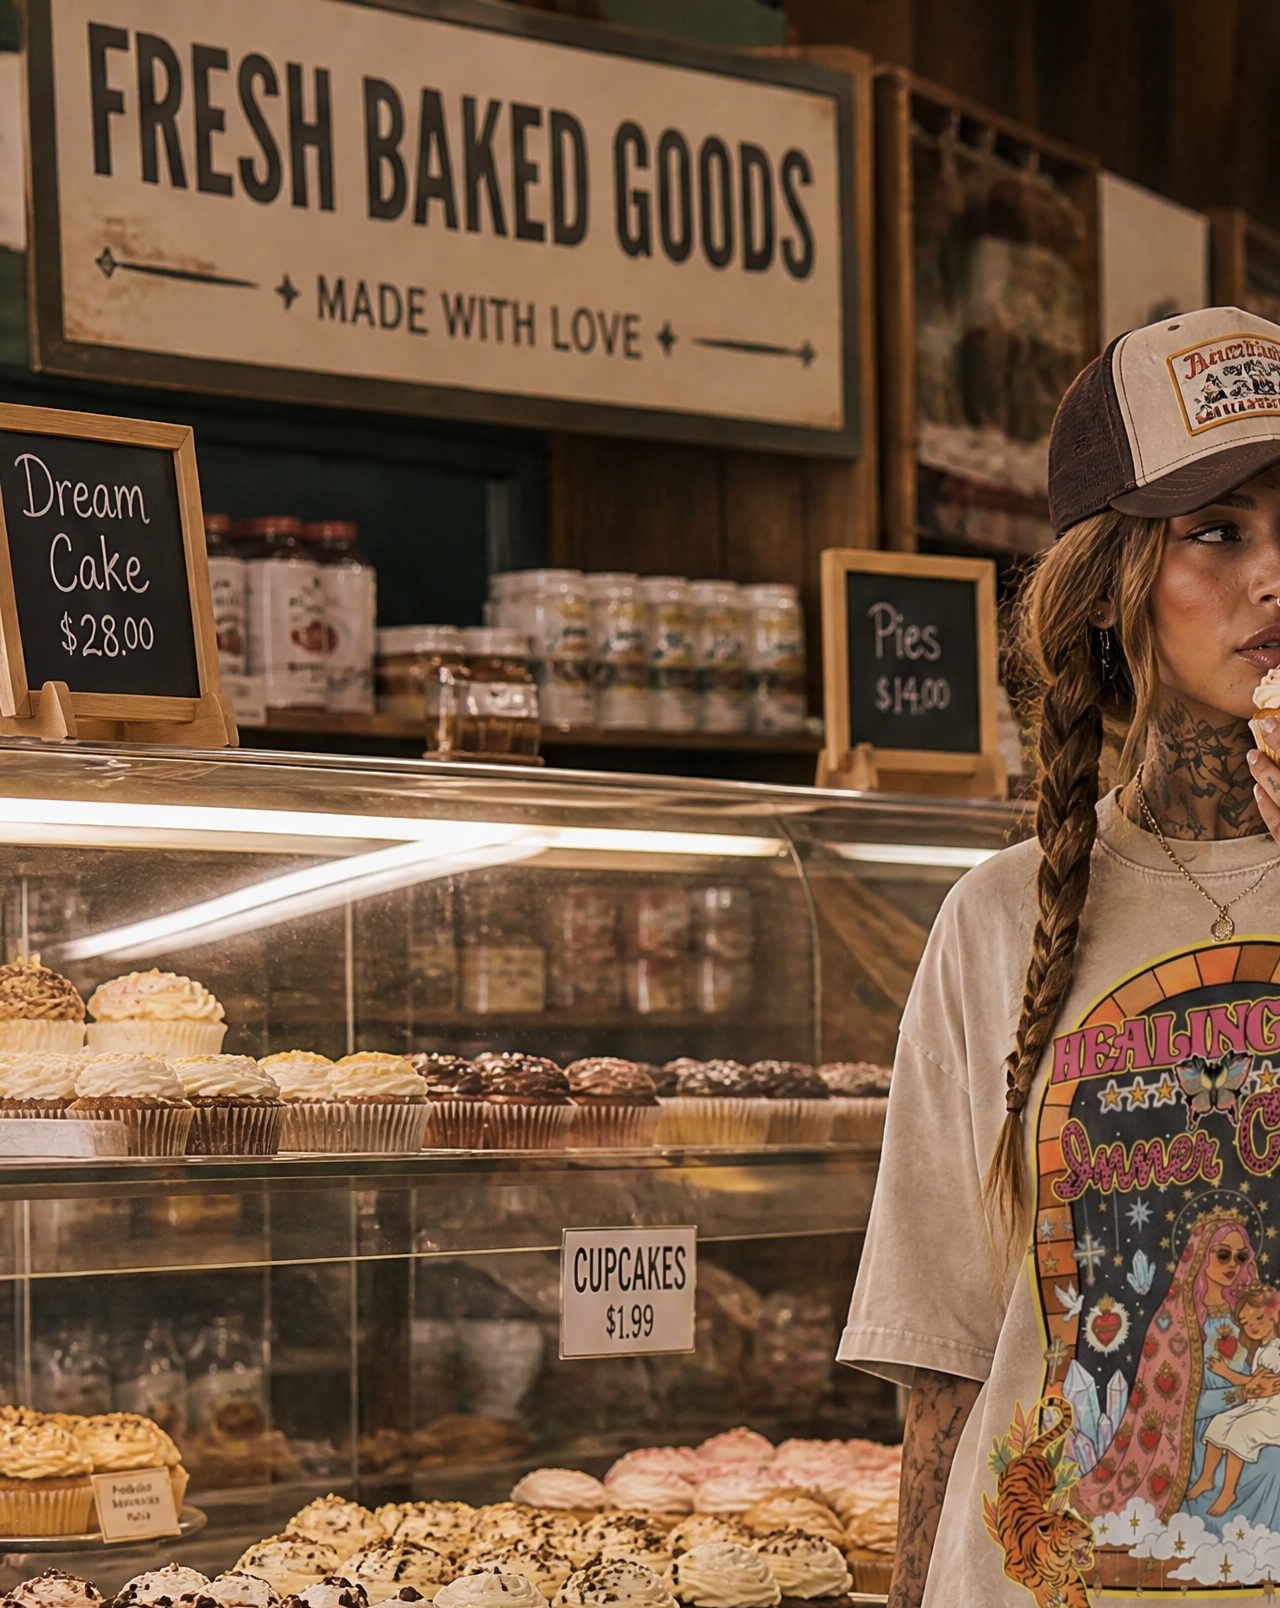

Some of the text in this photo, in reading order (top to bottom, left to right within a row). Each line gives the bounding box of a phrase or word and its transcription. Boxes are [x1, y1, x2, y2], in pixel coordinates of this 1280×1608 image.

[88, 20, 816, 281] FRESH BAKED GOODS
[317, 274, 643, 360] MADE WITH LOVE
[14, 453, 150, 524] Dream
[50, 533, 149, 593] Cake
[60, 611, 154, 657] $28.00
[867, 601, 942, 661] Pies
[874, 675, 951, 715] $14.00
[1053, 1118, 1223, 1202] Inner
[574, 1245, 687, 1293] CUPCAKES
[606, 1304, 654, 1340] $1.99
